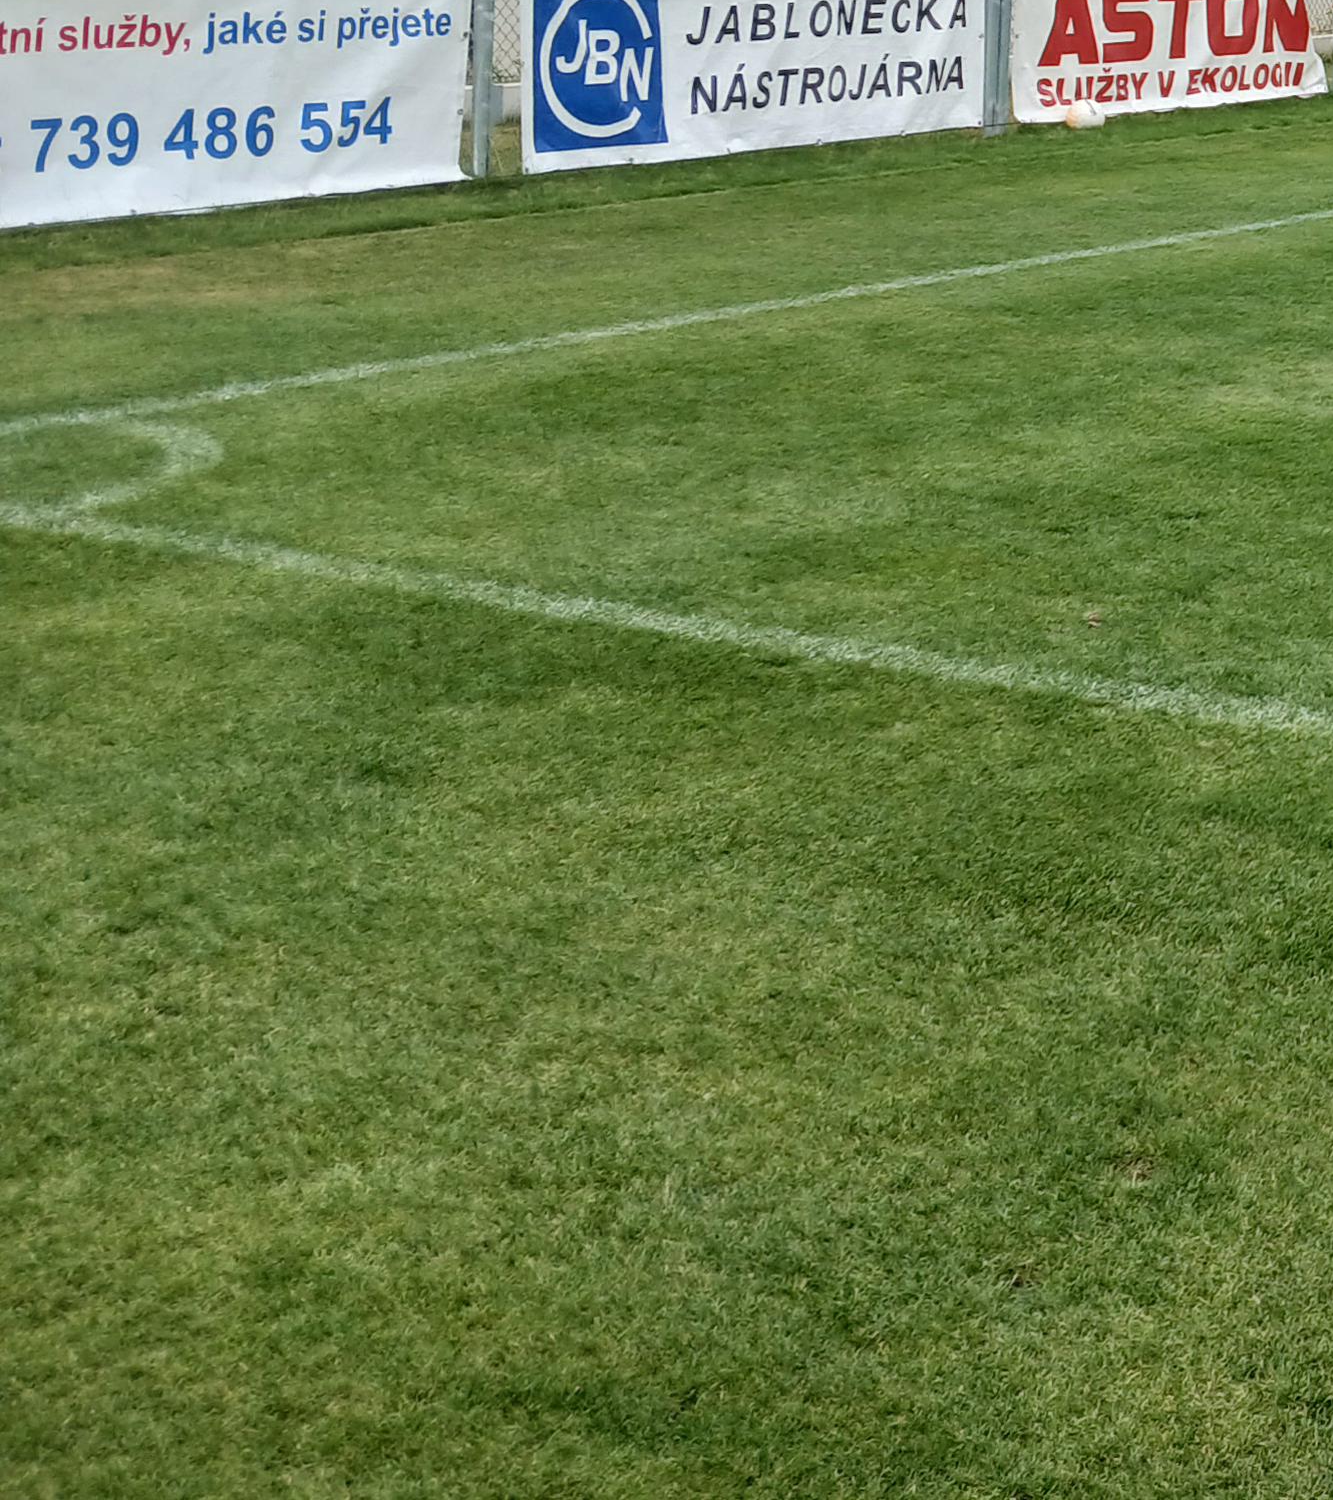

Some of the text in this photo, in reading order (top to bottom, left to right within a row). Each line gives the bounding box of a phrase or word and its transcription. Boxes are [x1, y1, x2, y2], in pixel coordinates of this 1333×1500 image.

[58, 15, 190, 56] služby,
[203, 11, 287, 54] jaké
[298, 9, 325, 44] si
[337, 6, 452, 48] přejete
[556, 18, 654, 102] JBN
[690, 53, 964, 115] NÁSTROJÁRNA
[1036, 67, 1149, 107] SLUŽBY
[1157, 70, 1175, 98] V
[30, 97, 393, 173] 739 486 554
